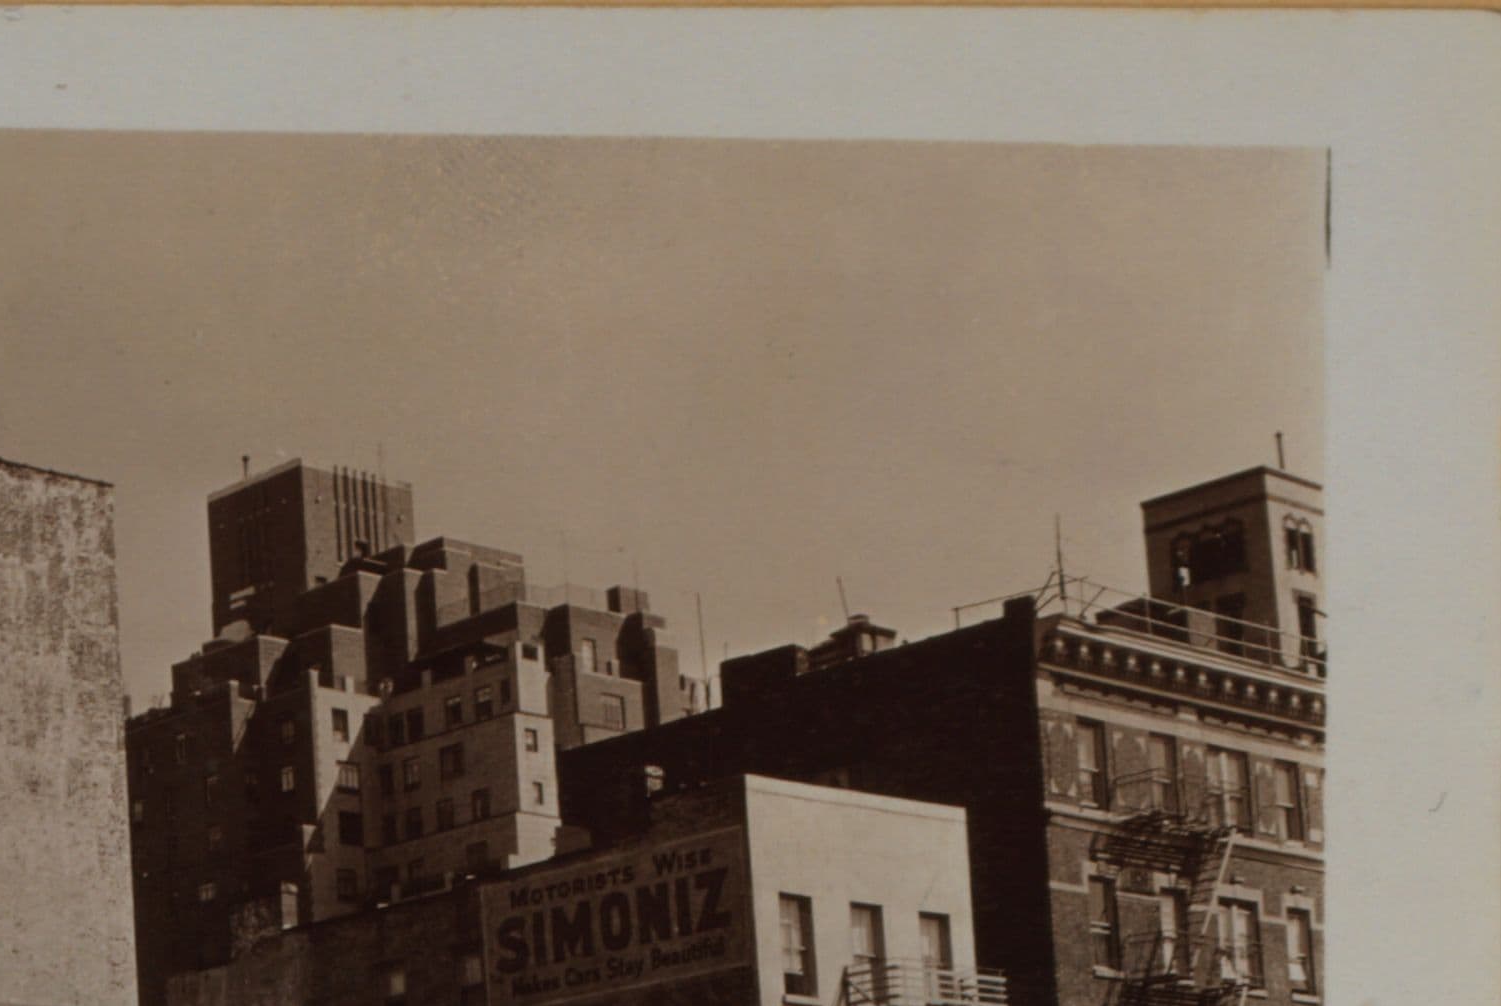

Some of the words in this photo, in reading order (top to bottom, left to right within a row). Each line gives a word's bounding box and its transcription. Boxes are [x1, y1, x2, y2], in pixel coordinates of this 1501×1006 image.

[496, 867, 733, 974] SIMONIZ
[564, 965, 602, 987] Cars
[606, 955, 645, 980] Stay
